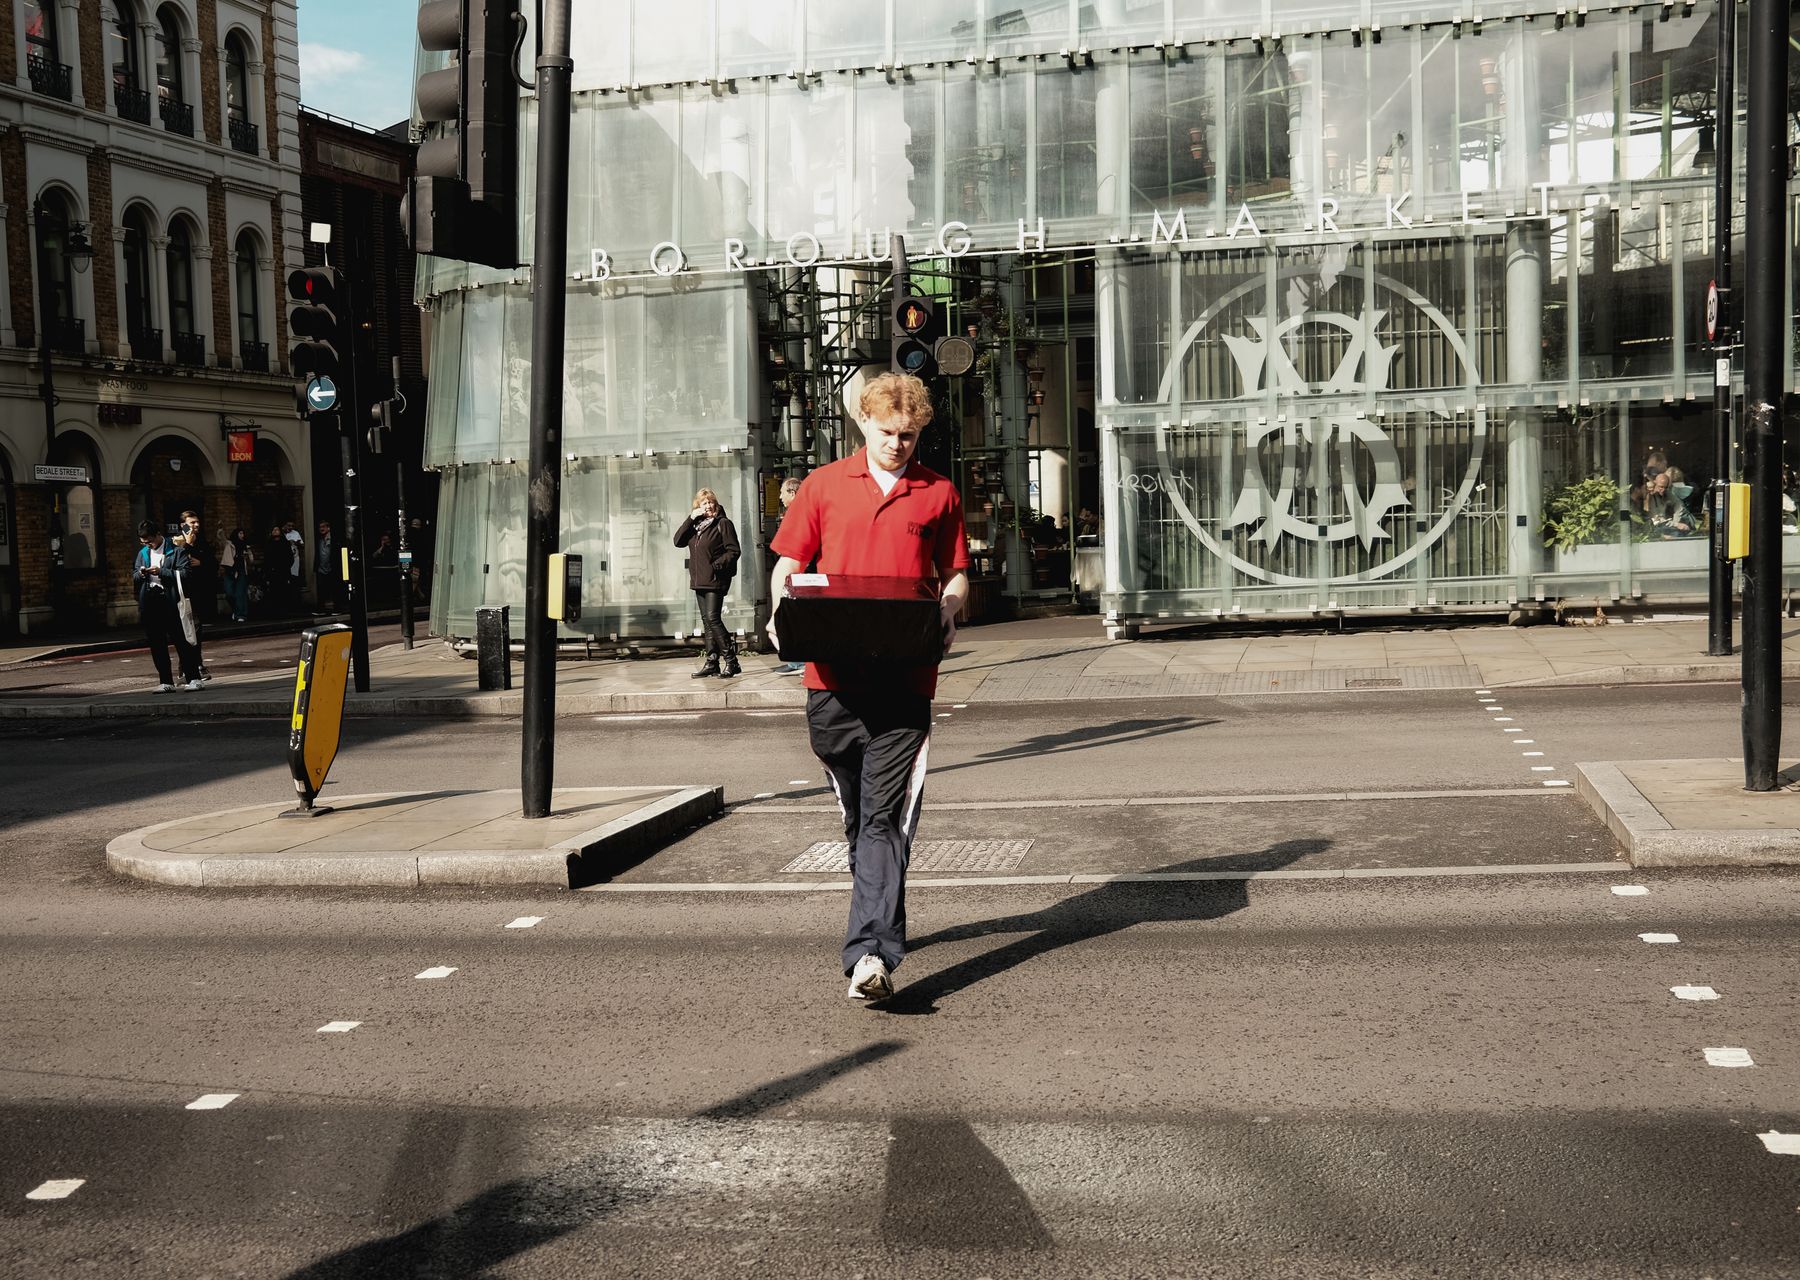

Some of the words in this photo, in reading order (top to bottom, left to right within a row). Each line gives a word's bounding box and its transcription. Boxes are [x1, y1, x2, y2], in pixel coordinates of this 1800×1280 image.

[591, 216, 1046, 281] BOROUGH
[1150, 181, 1552, 244] MARKET
[1709, 297, 1715, 323] 20
[106, 379, 124, 389] FAST
[126, 380, 148, 391] FOOD
[231, 452, 252, 461] LEON
[36, 466, 58, 475] BEDALE
[59, 467, 80, 476] STREET
